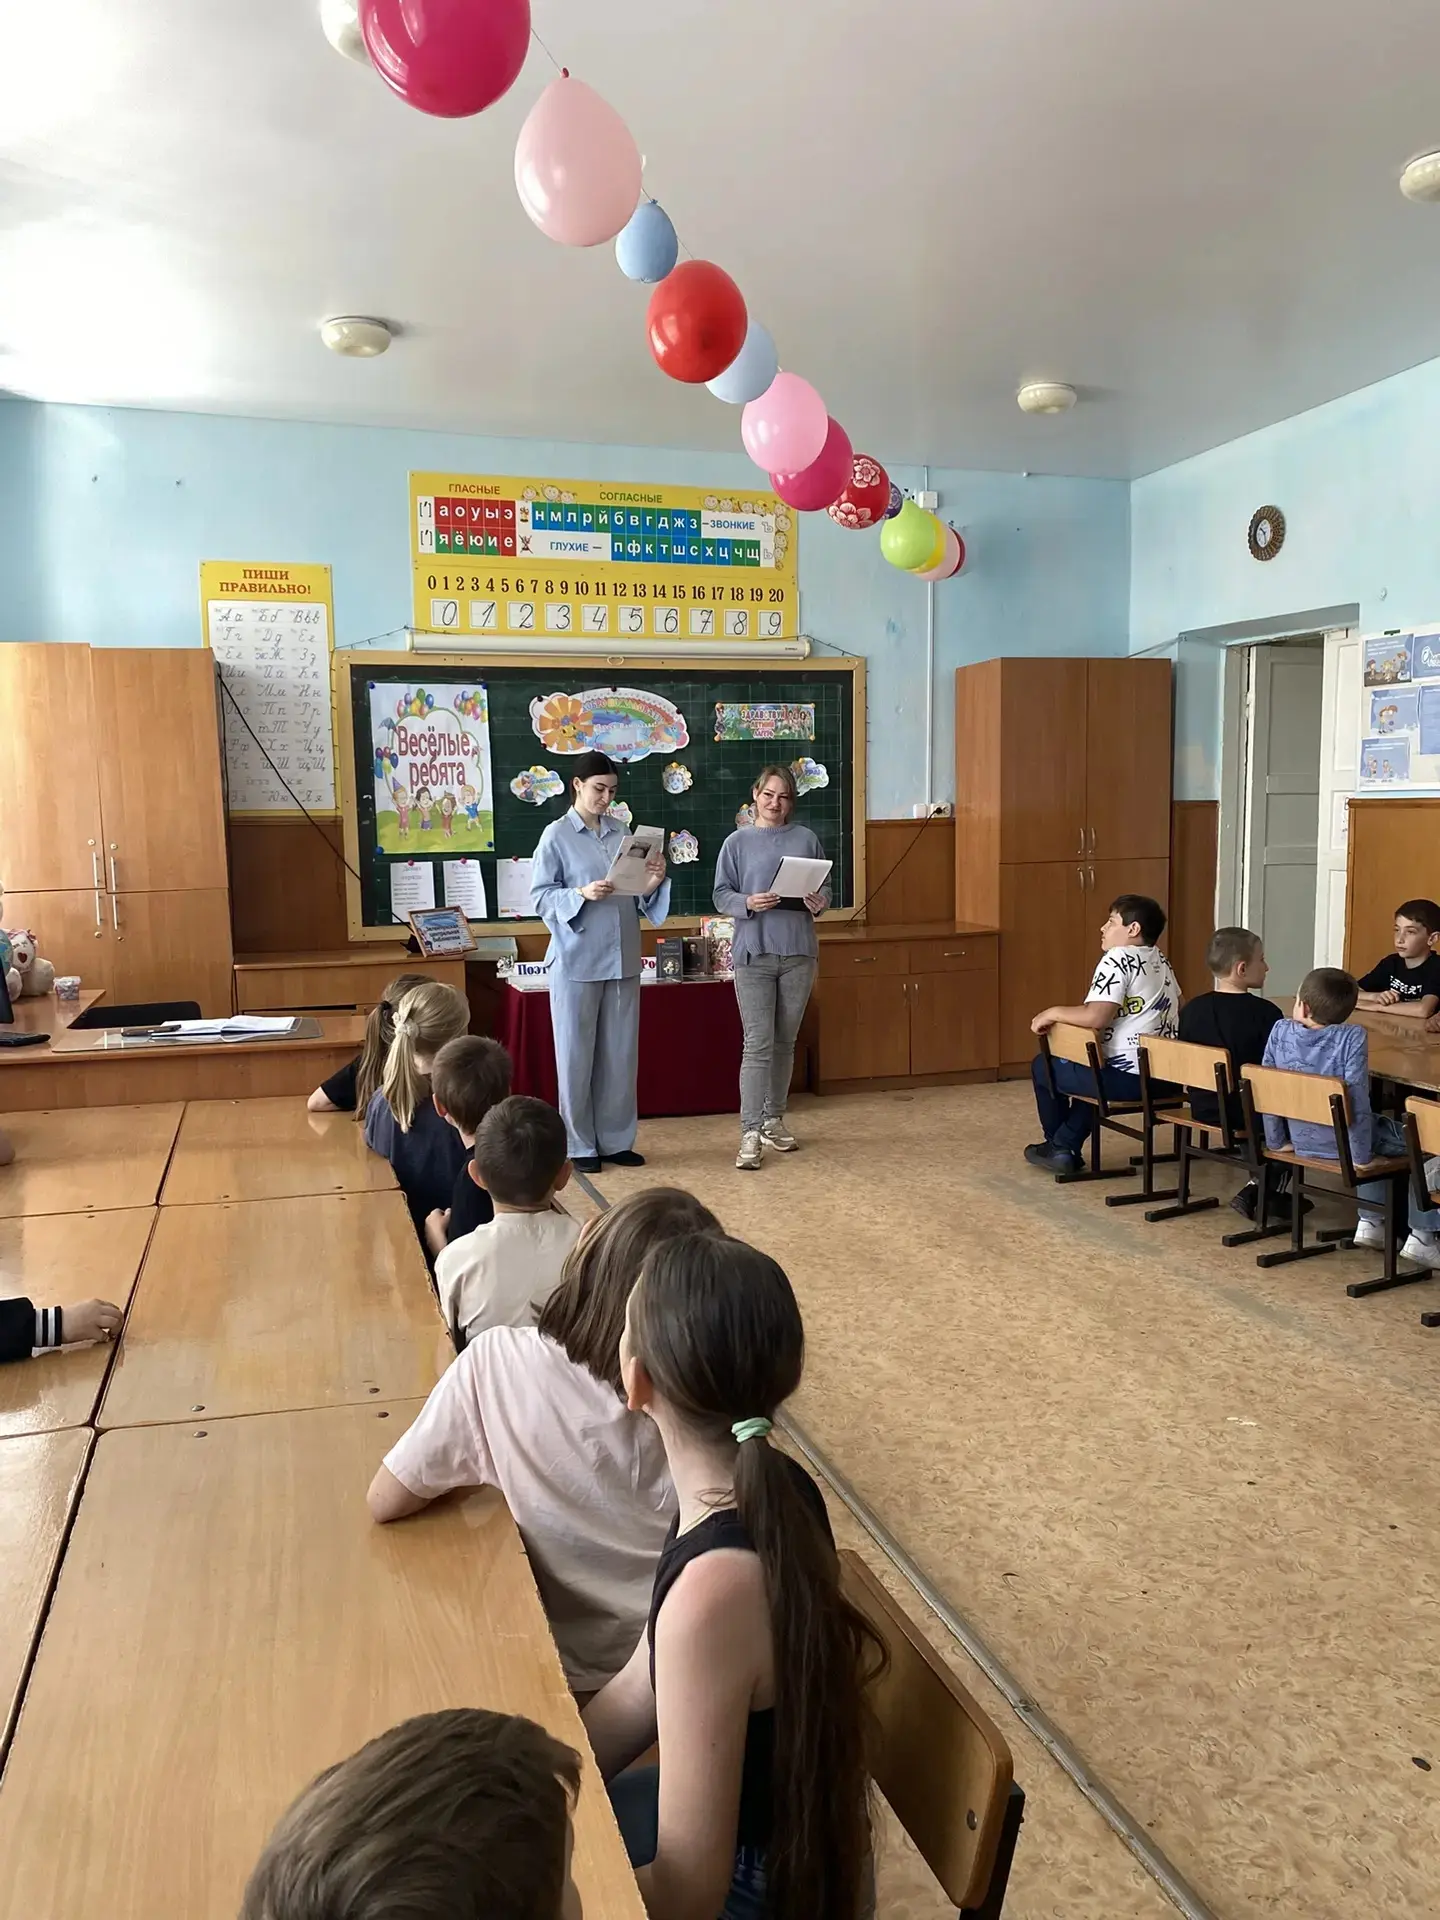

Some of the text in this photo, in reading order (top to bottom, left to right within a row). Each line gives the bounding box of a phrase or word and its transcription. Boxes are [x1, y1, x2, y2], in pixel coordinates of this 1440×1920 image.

[448, 483, 501, 495] ГЛАСНЫЕ
[599, 491, 663, 504] СОГЛАСНЫЕ
[550, 541, 588, 552] ГЛУХИЕ
[243, 569, 290, 581] ПИШИ
[219, 582, 312, 595] ПРАВИЛЬНО!
[428, 575, 784, 602] 0 1 2 3 4 5 6 7 8 9 10 11 12 13 14 15 16 17 18 19 20
[442, 601, 782, 636] 0 1 2 3 4 5 6 7 8 9
[397, 725, 471, 756] Весёлые
[409, 751, 466, 793] ребята
